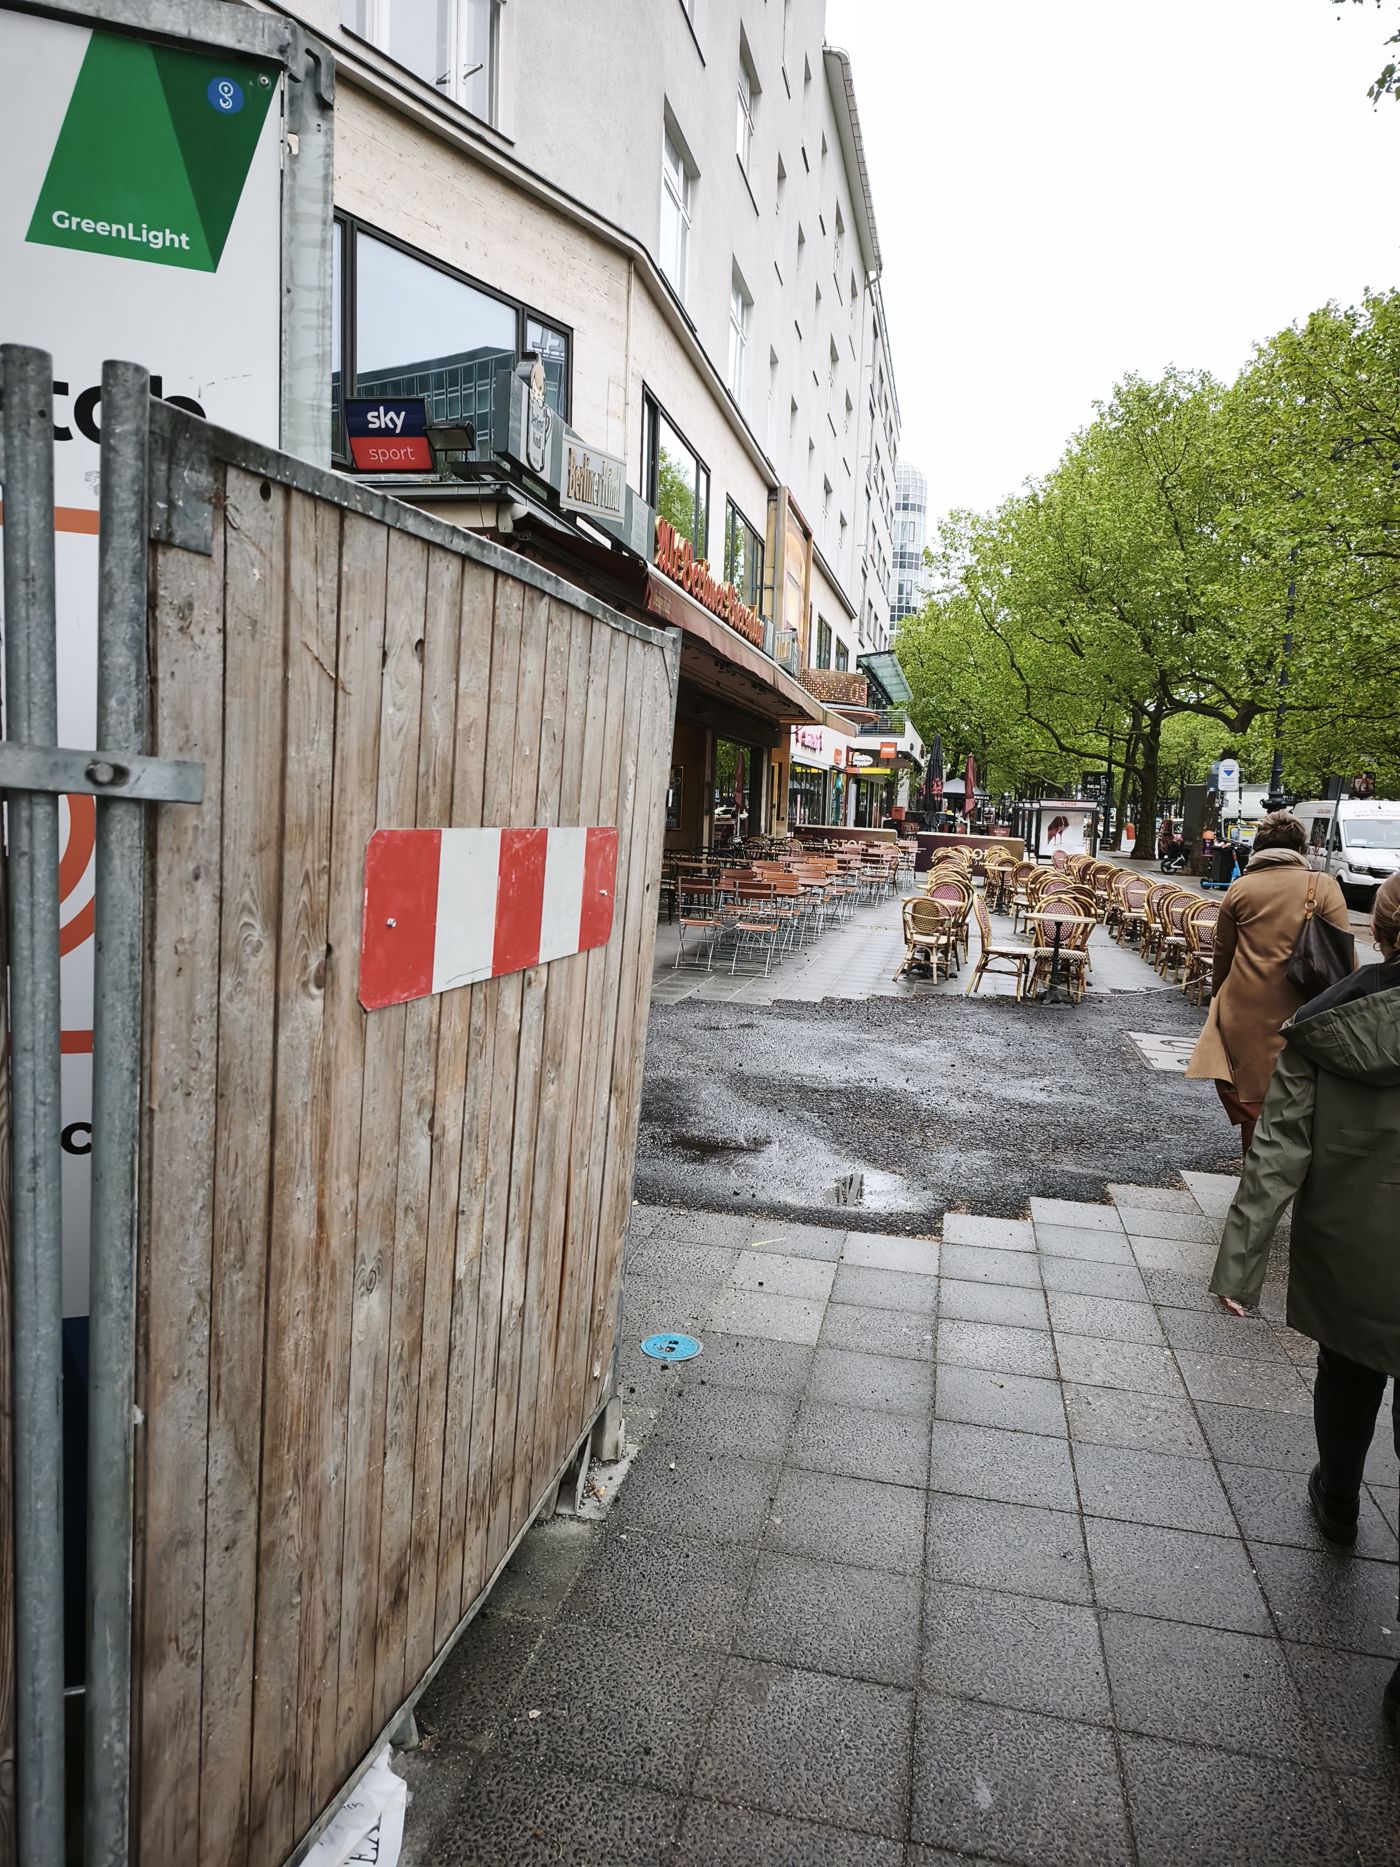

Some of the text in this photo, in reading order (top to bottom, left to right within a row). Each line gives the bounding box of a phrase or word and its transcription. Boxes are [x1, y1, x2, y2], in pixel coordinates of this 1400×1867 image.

[51, 210, 191, 250] GreenLight
[366, 405, 406, 434] sky
[368, 446, 416, 463] sport
